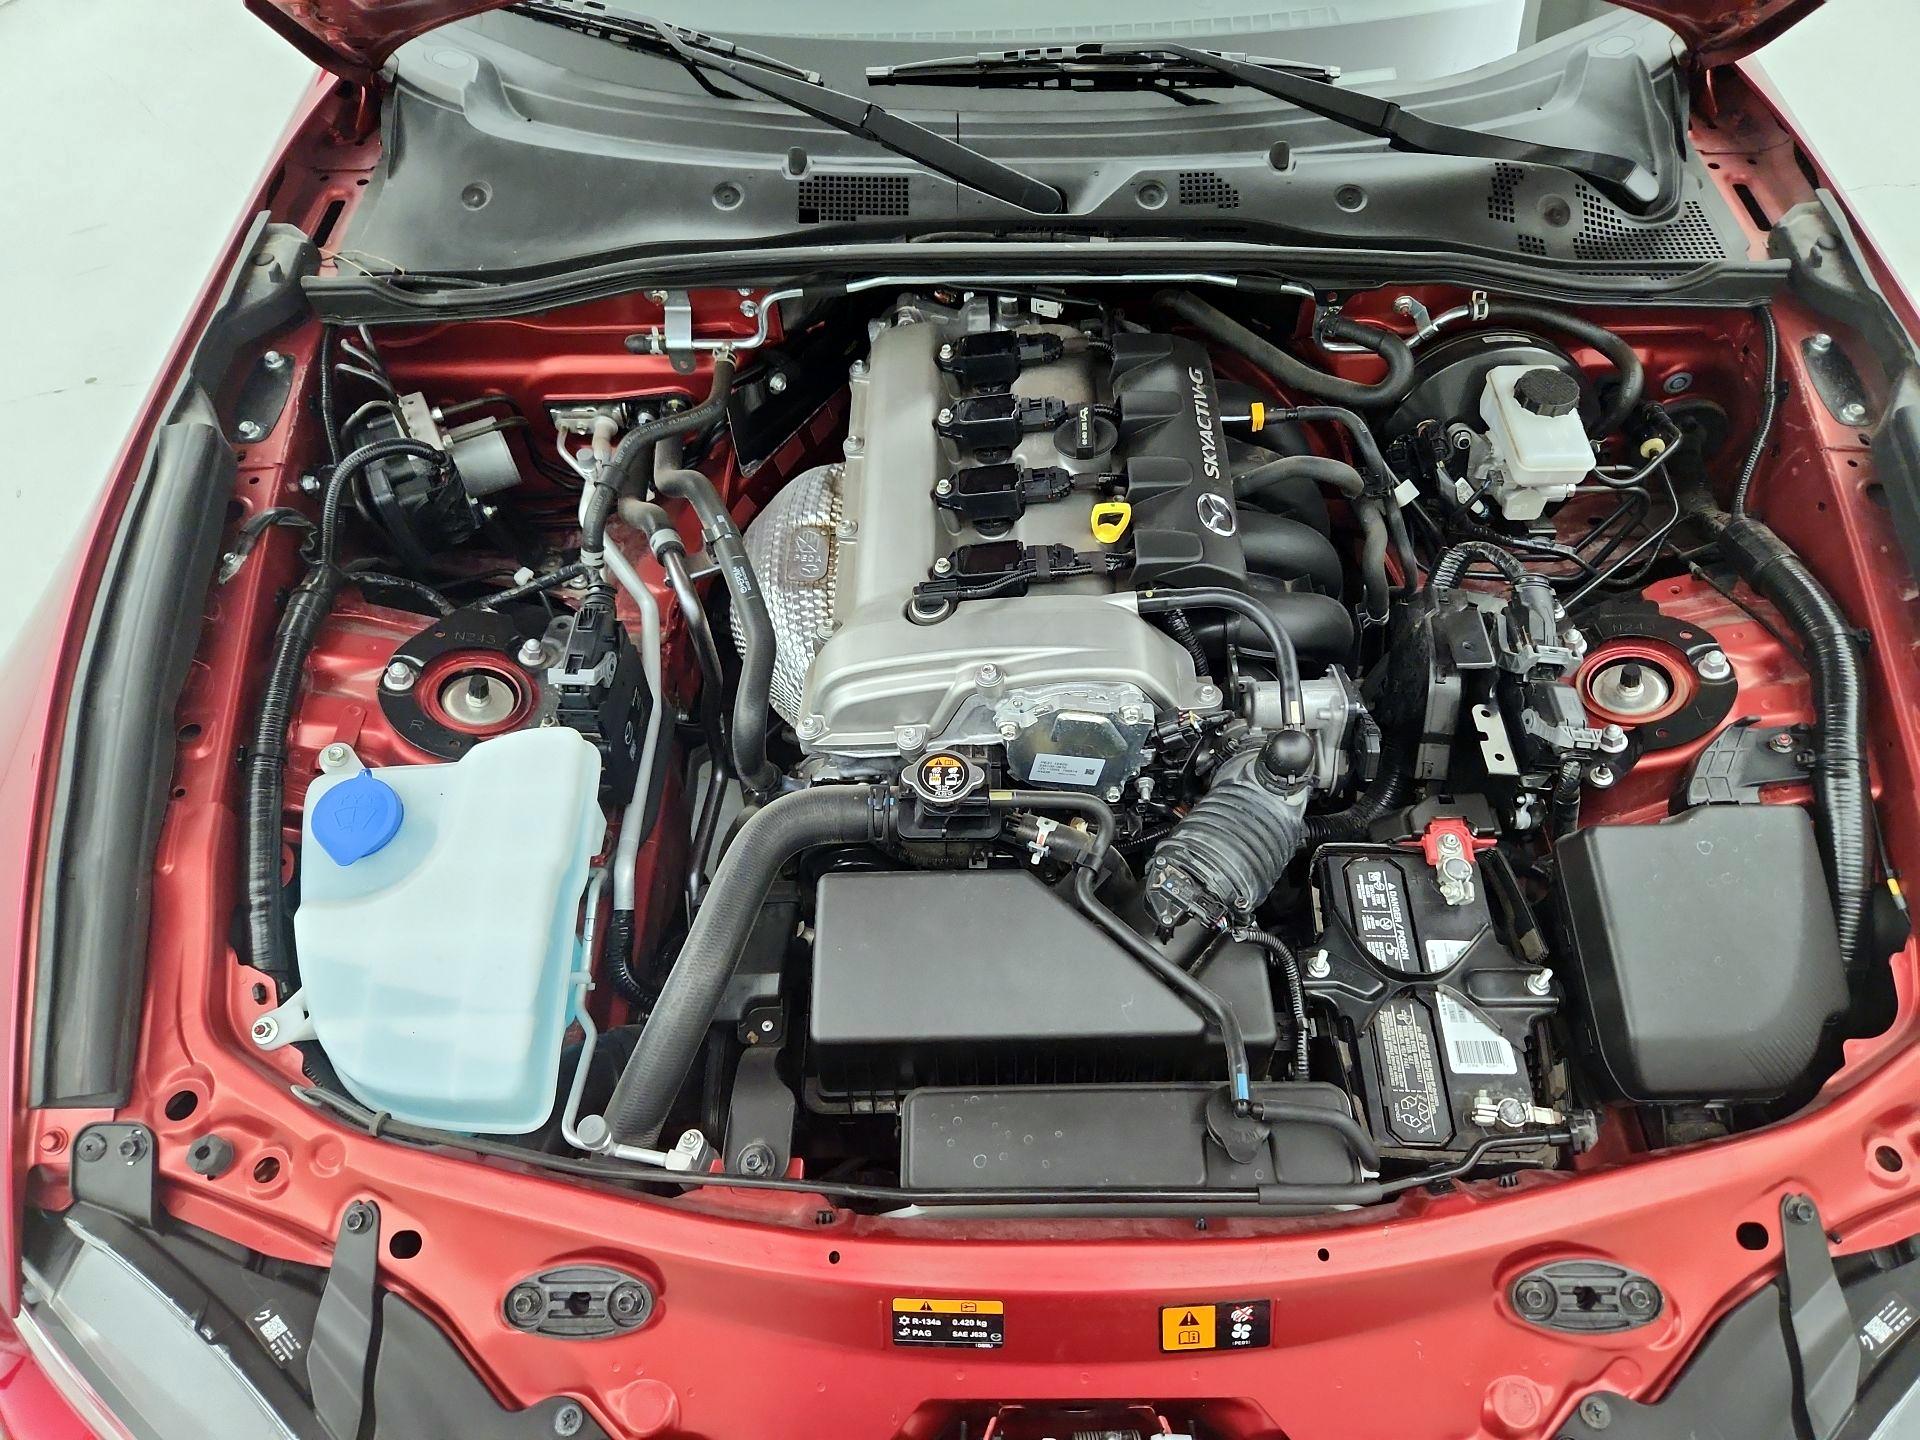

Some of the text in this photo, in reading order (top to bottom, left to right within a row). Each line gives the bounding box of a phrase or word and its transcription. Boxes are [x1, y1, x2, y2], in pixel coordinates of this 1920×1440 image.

[1188, 366, 1220, 480] SKYACTIV-G
[1389, 891, 1402, 923] DANGER
[1397, 930, 1410, 960] POISON
[912, 1317, 988, 1328] R-134a 0.420 kg
[912, 1329, 932, 1337] PAG
[952, 1330, 969, 1338] SAE
